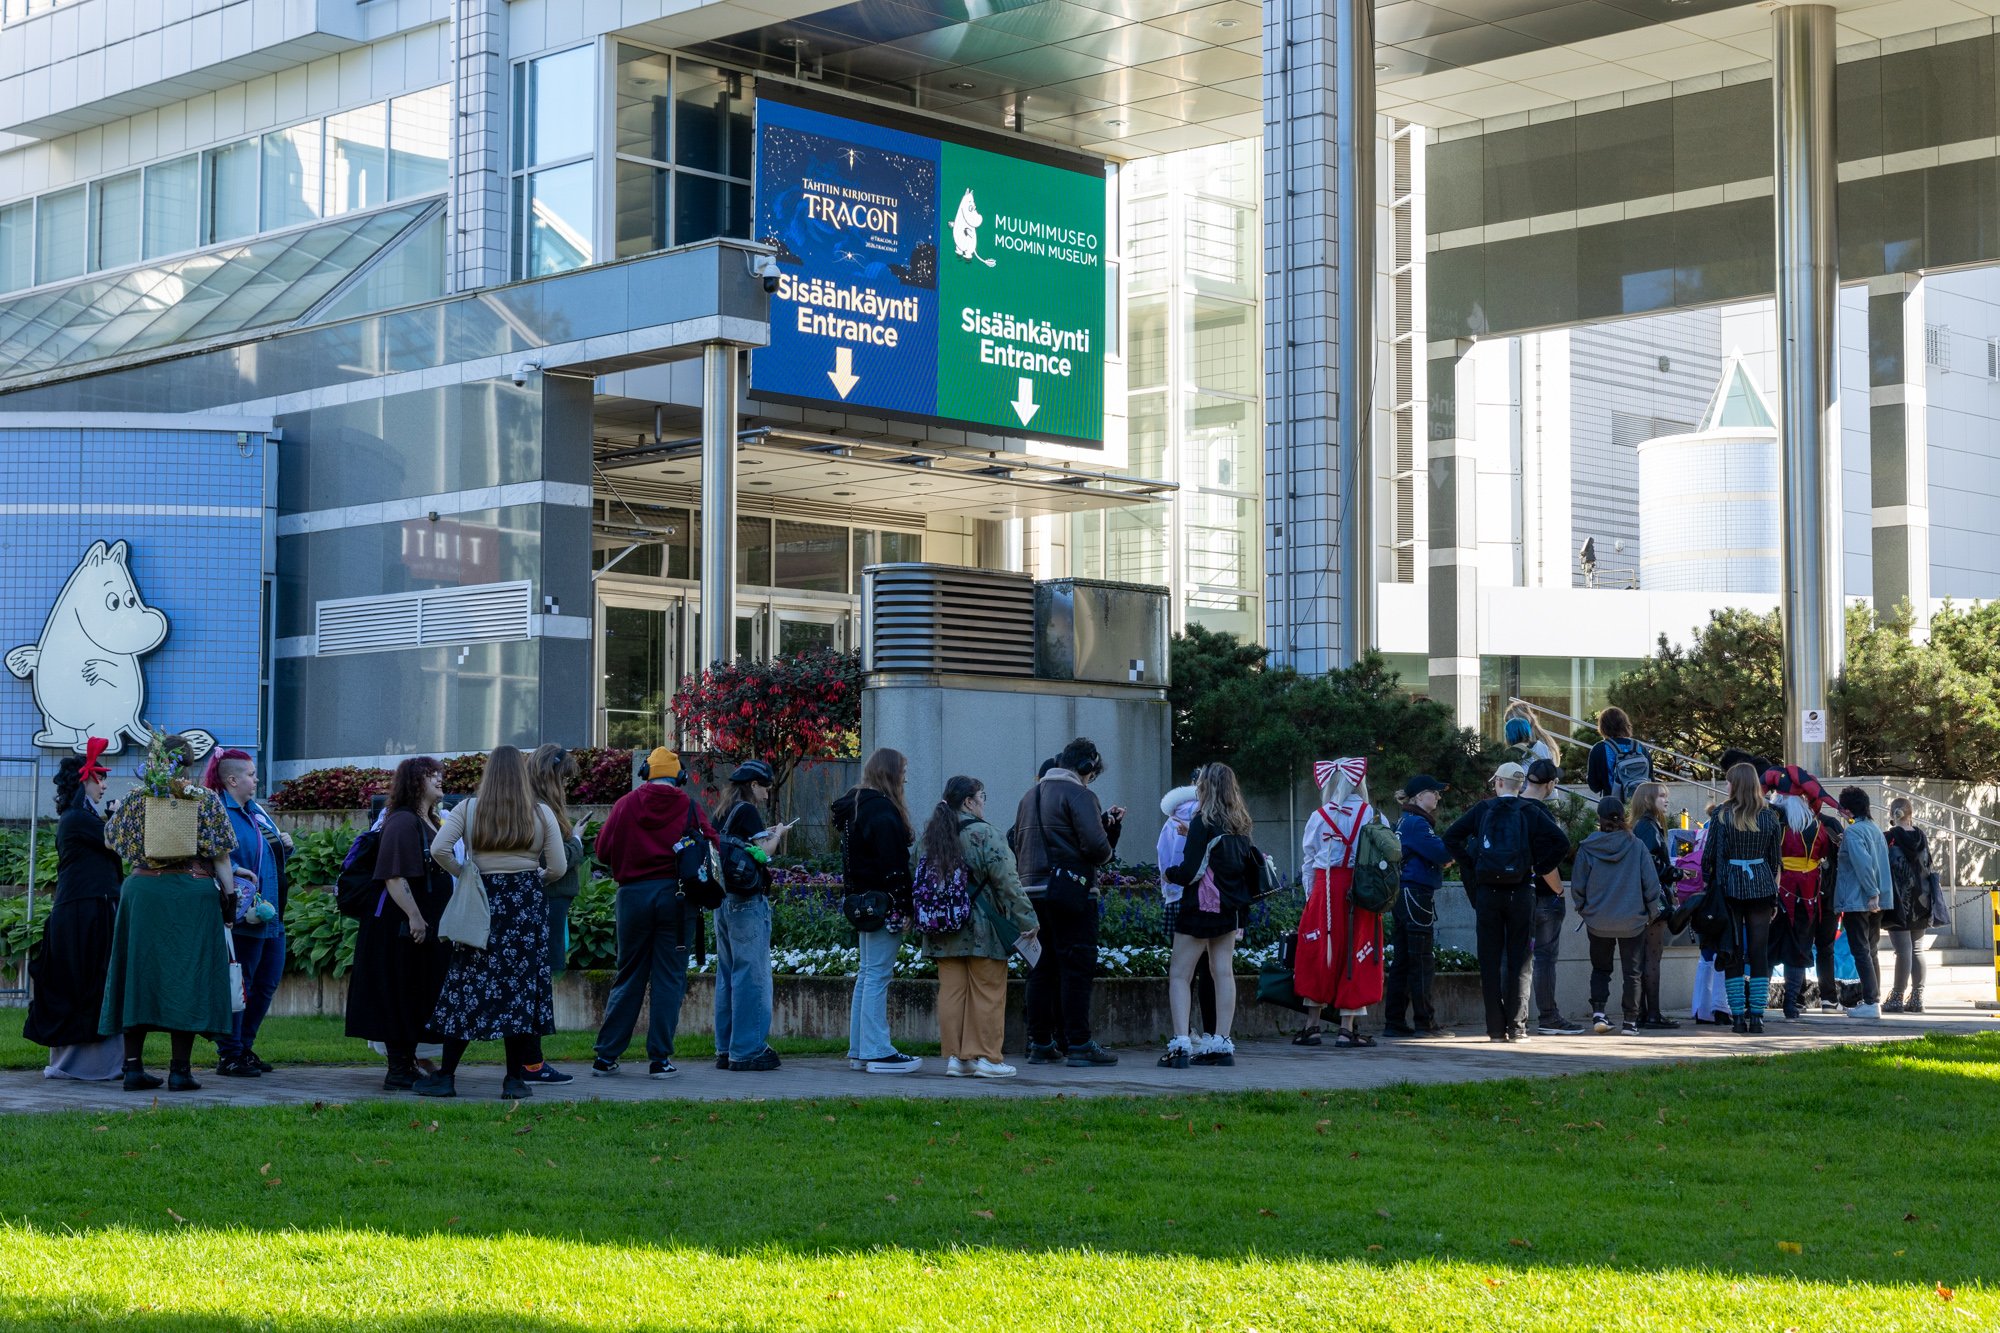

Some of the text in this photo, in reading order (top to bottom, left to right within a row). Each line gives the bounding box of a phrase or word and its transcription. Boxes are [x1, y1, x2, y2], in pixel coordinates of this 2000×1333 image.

[802, 178, 898, 208] TÄHTIIN KIRJOITETTU
[803, 194, 898, 235] TRACON
[995, 213, 1098, 248] MUUMIMUSEO
[995, 234, 1098, 267] MOOMIN MUSEUM
[777, 273, 918, 322] Sisäänkäynti
[797, 307, 898, 348] Entrance
[961, 308, 1090, 353] Sisäänkäynti
[980, 339, 1072, 377] Entrance
